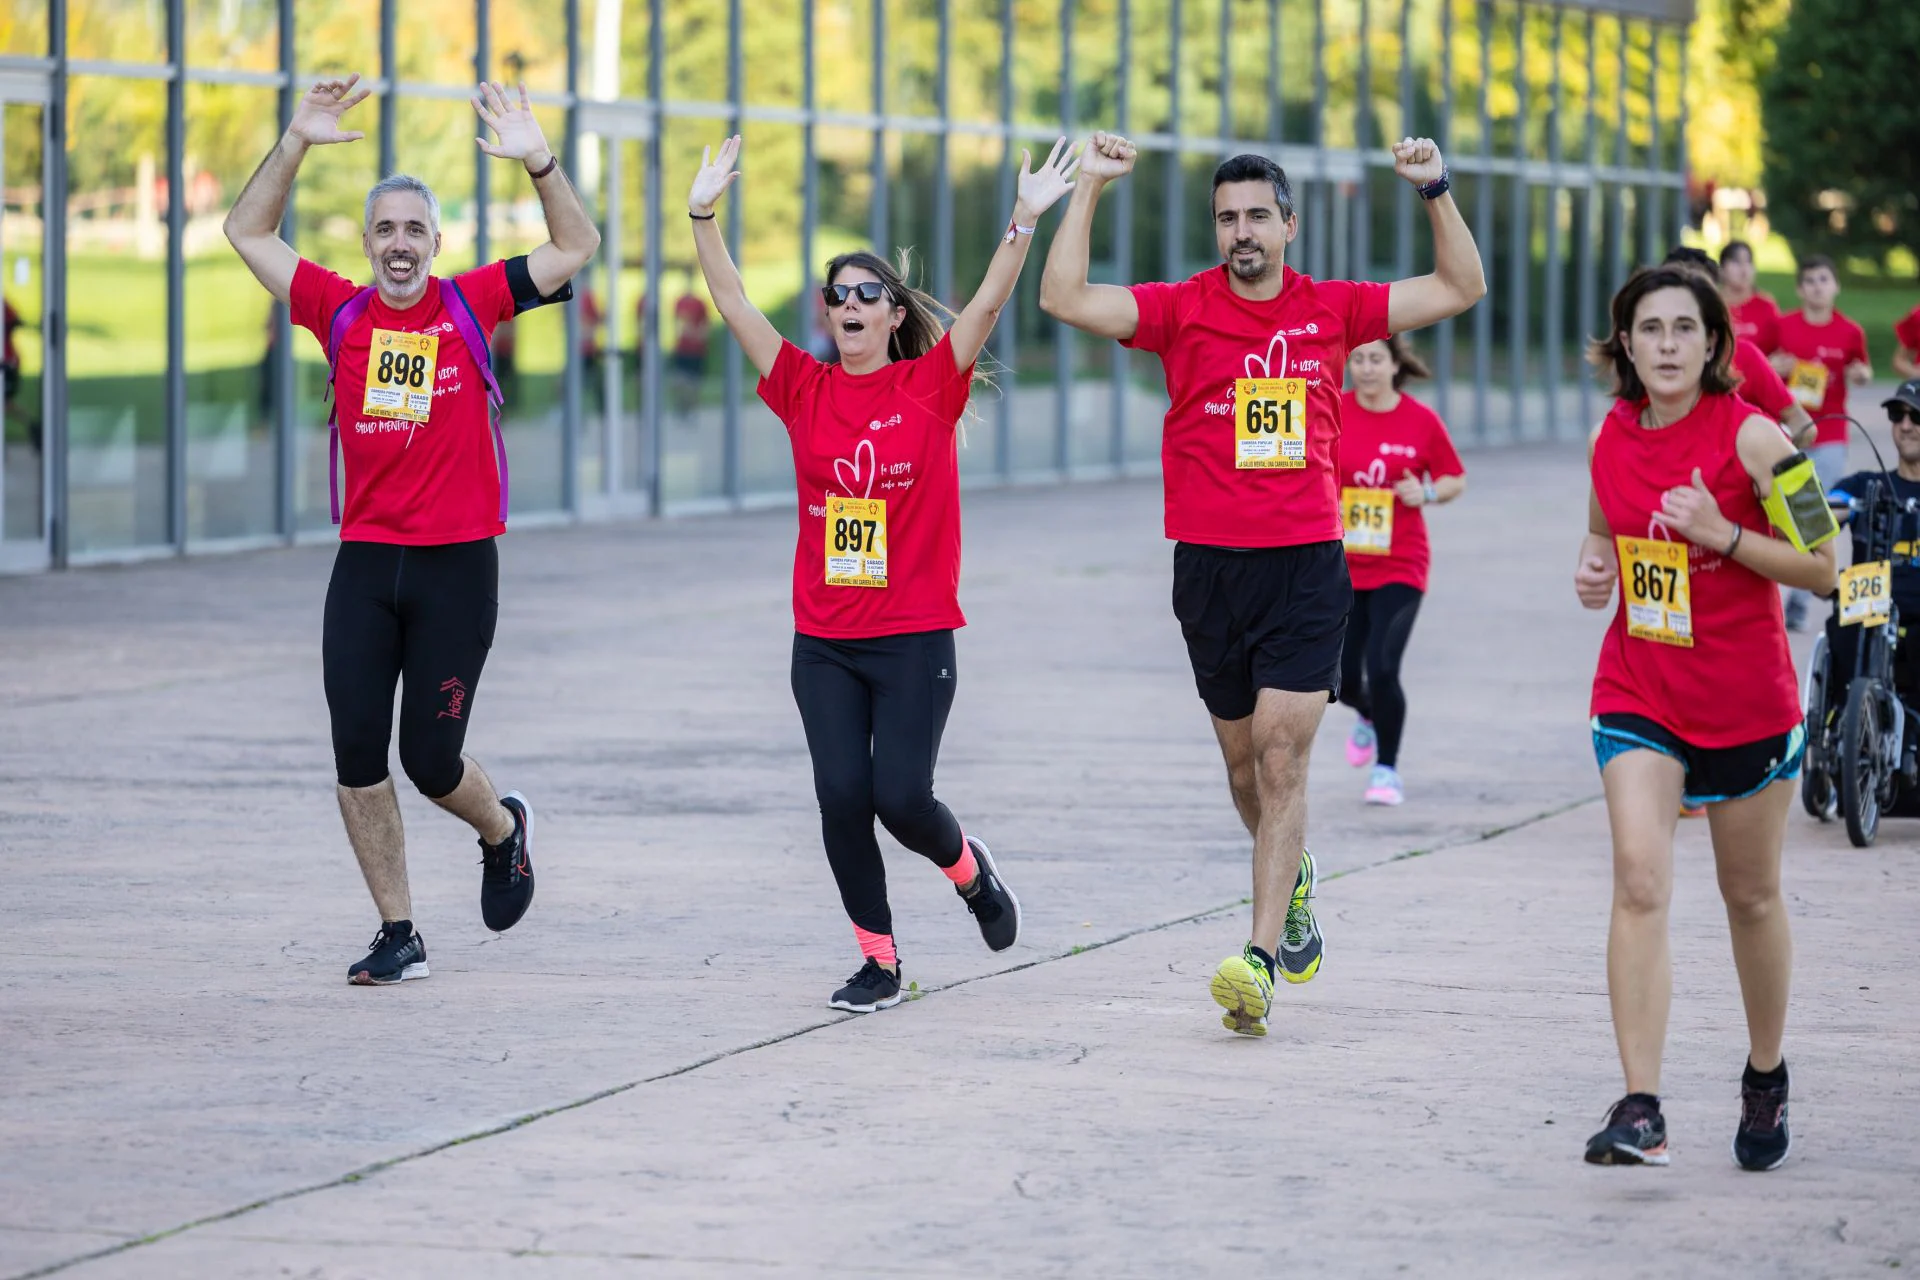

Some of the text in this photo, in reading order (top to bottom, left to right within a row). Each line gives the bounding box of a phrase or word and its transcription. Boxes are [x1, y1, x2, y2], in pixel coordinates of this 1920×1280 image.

[377, 350, 426, 388] 898
[438, 365, 459, 381] VIDA
[1299, 359, 1321, 372] VIDA
[1226, 387, 1236, 399] Co
[1204, 401, 1230, 416] SALUD
[1246, 399, 1292, 434] 651
[355, 419, 410, 435] SALUD MENTAL
[889, 461, 912, 475] VIDA
[808, 503, 826, 518] SALU
[1349, 503, 1384, 530] 615
[834, 517, 877, 553] 897
[1632, 561, 1678, 604] 867
[1847, 575, 1883, 601] 326
